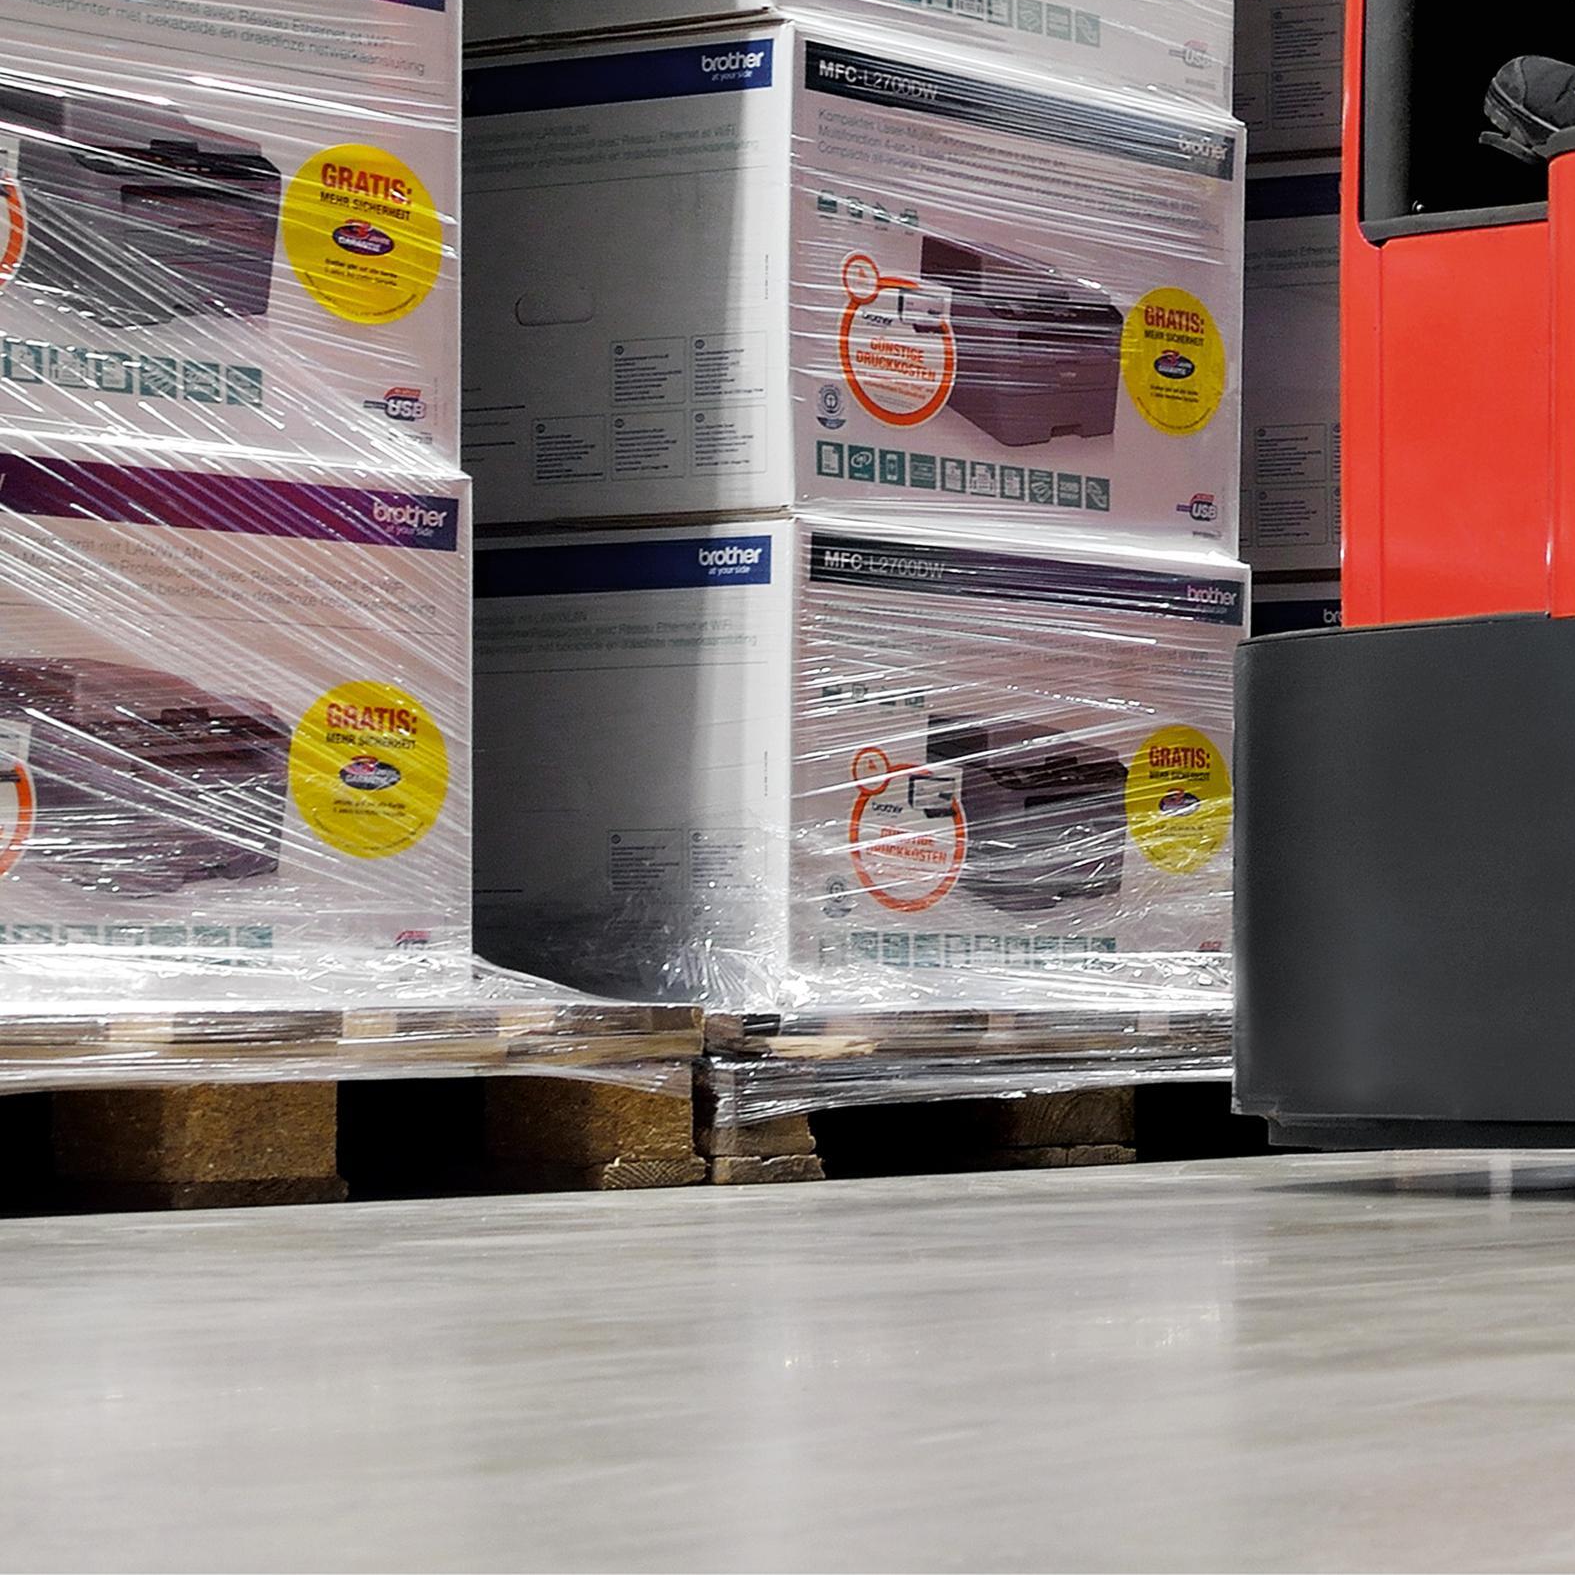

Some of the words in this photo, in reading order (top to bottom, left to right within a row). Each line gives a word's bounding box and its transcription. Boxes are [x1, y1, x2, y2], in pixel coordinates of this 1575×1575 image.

[700, 50, 764, 73] brother
[818, 58, 939, 102] MFC-L2700DW
[321, 162, 413, 207] GRATIS:
[320, 190, 351, 208] MEHR
[352, 198, 411, 222] SICHERHEIT
[1143, 303, 1207, 335] GRATIS:
[869, 335, 926, 365] GÜNSTIGE
[855, 349, 937, 384] DRUCKKOSTEN
[385, 392, 426, 421] USB
[373, 500, 448, 531] brother
[1190, 500, 1219, 520] USB
[698, 546, 763, 567] brother
[1186, 583, 1239, 609] brother
[325, 702, 418, 737] GRATIS:
[1148, 744, 1212, 771] GRATIS:
